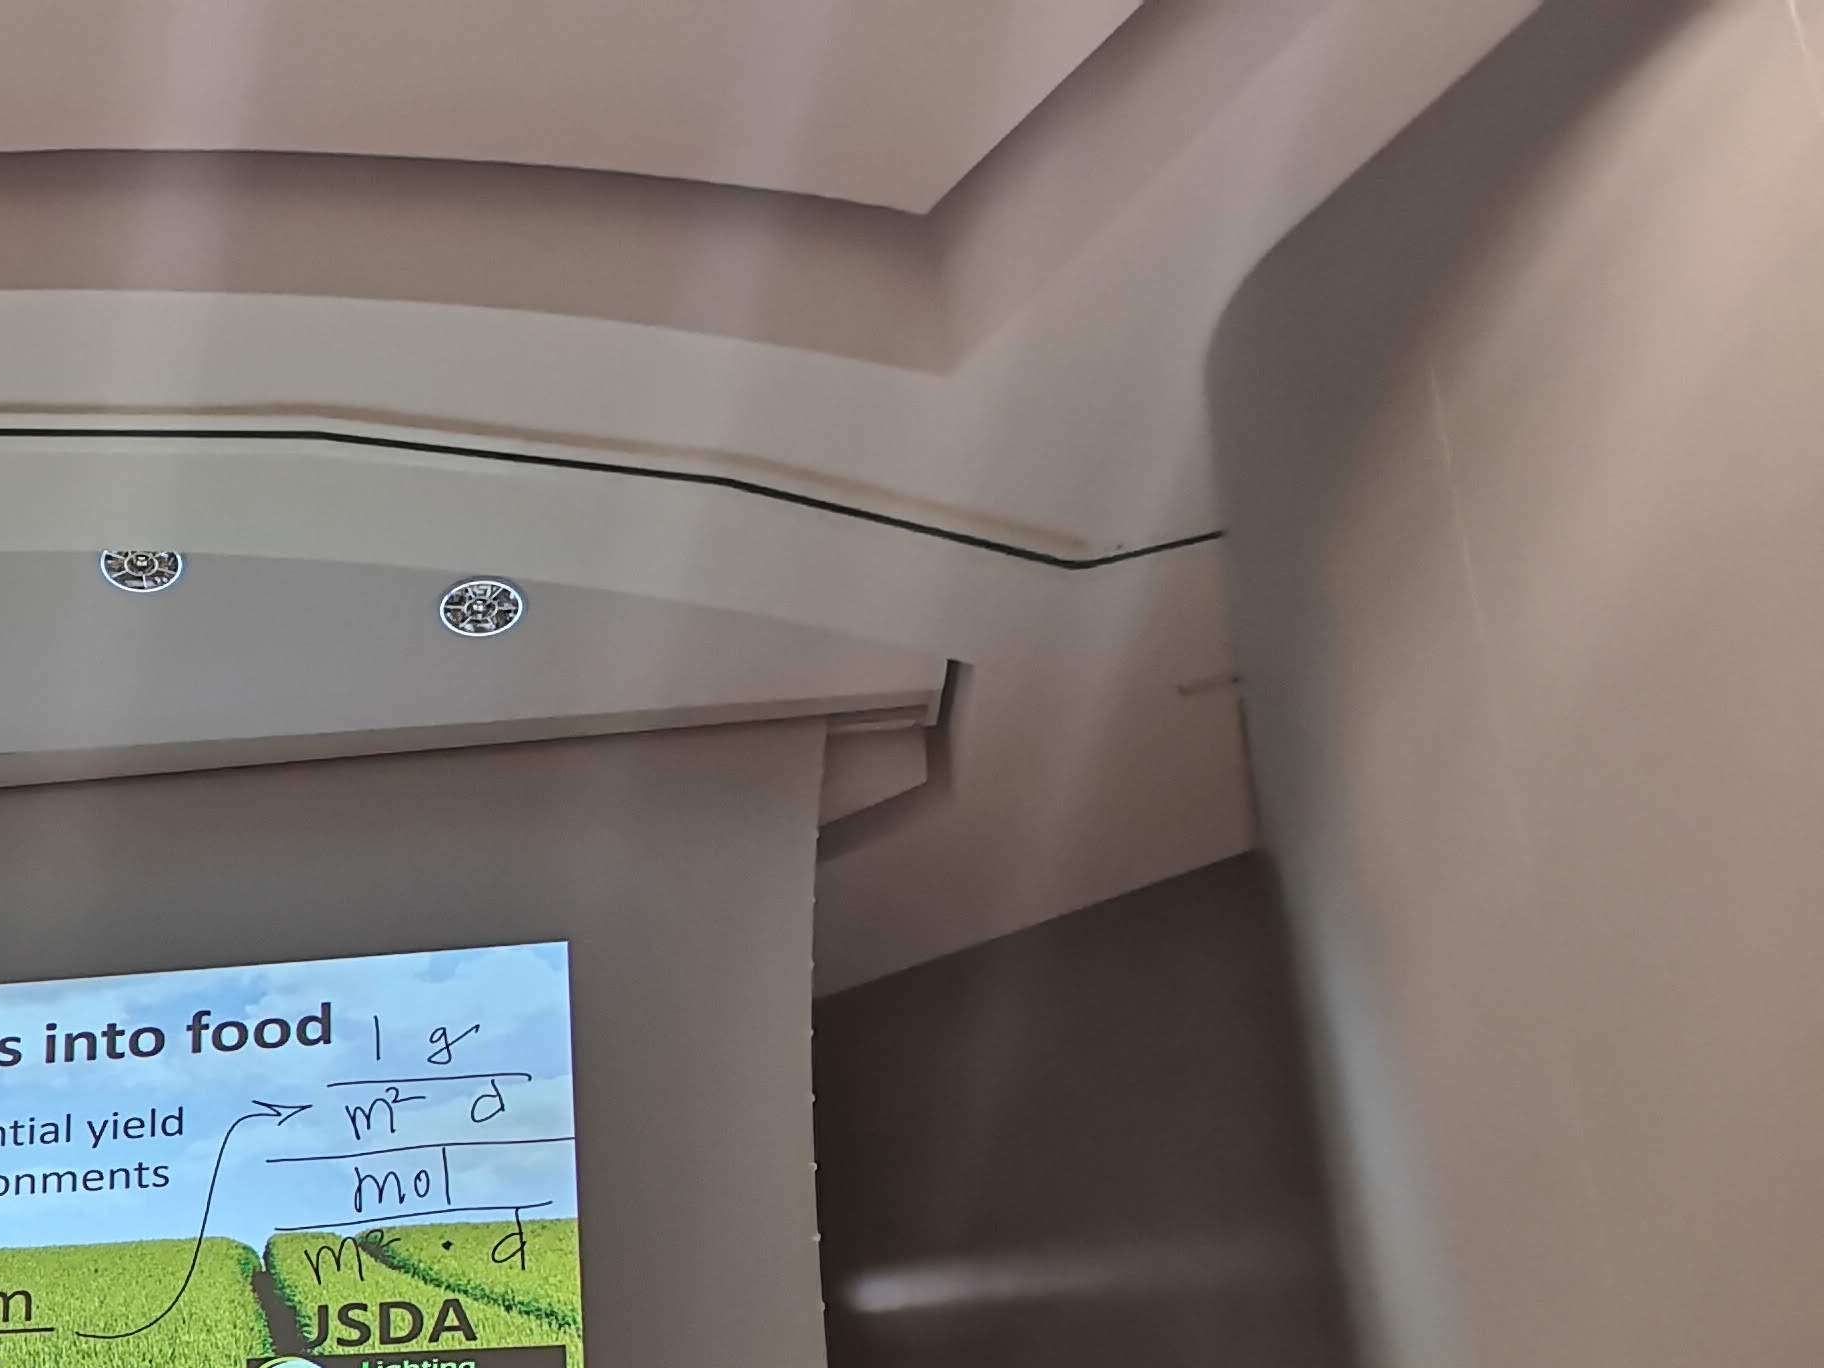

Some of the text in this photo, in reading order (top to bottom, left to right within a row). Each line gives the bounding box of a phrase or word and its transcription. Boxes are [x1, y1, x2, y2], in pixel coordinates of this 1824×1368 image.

[44, 1022, 165, 1065] into
[186, 1001, 333, 1055] food
[86, 1106, 186, 1149] yield
[353, 1146, 452, 1214] mol
